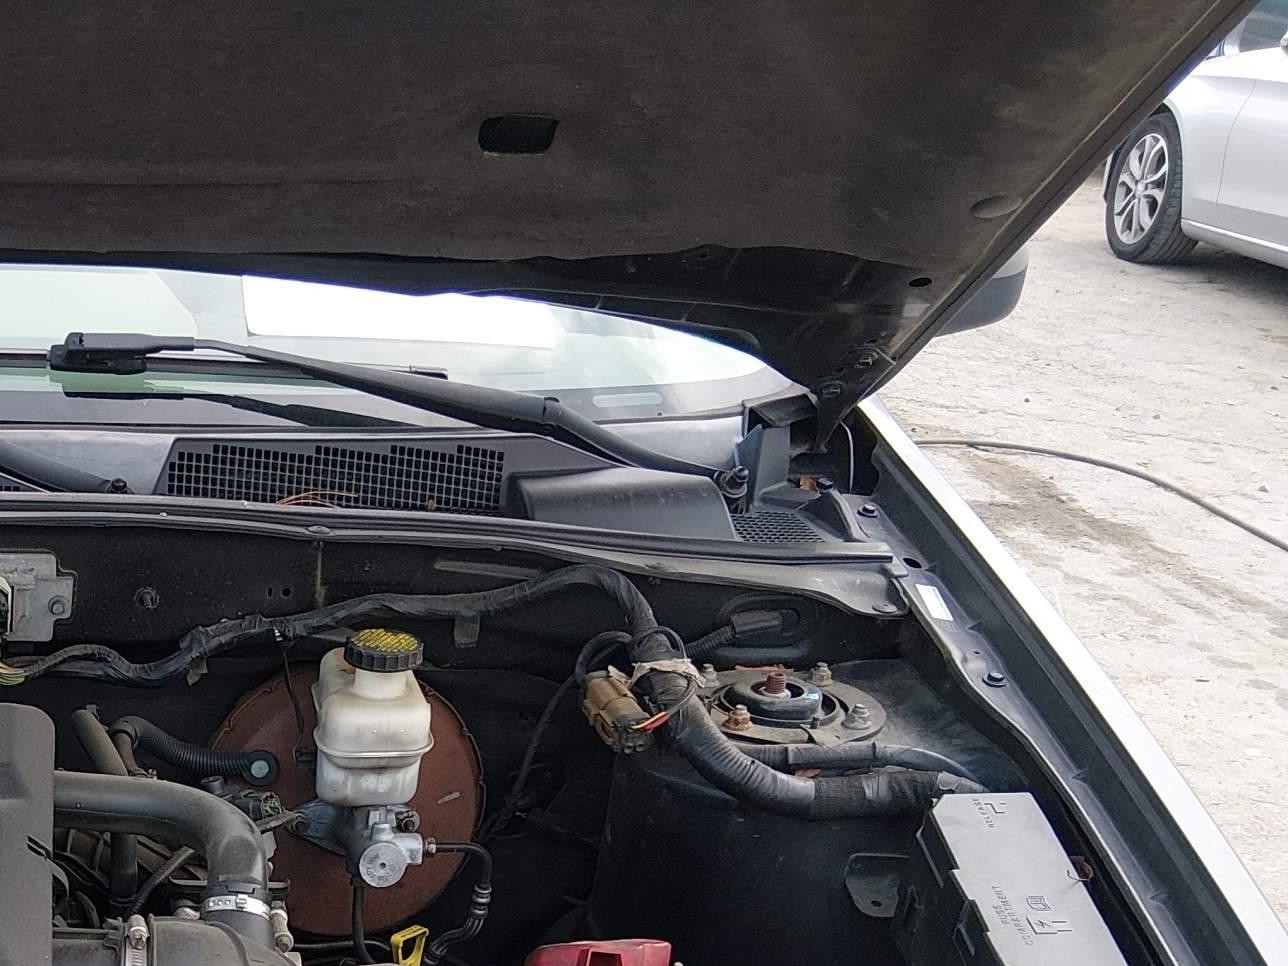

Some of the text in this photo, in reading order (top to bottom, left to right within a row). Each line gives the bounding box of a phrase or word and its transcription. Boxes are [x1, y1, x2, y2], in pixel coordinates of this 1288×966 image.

[972, 798, 996, 828] RELEASE
[991, 885, 1034, 946] COMPARTMENT
[992, 905, 1011, 924] FUSE
